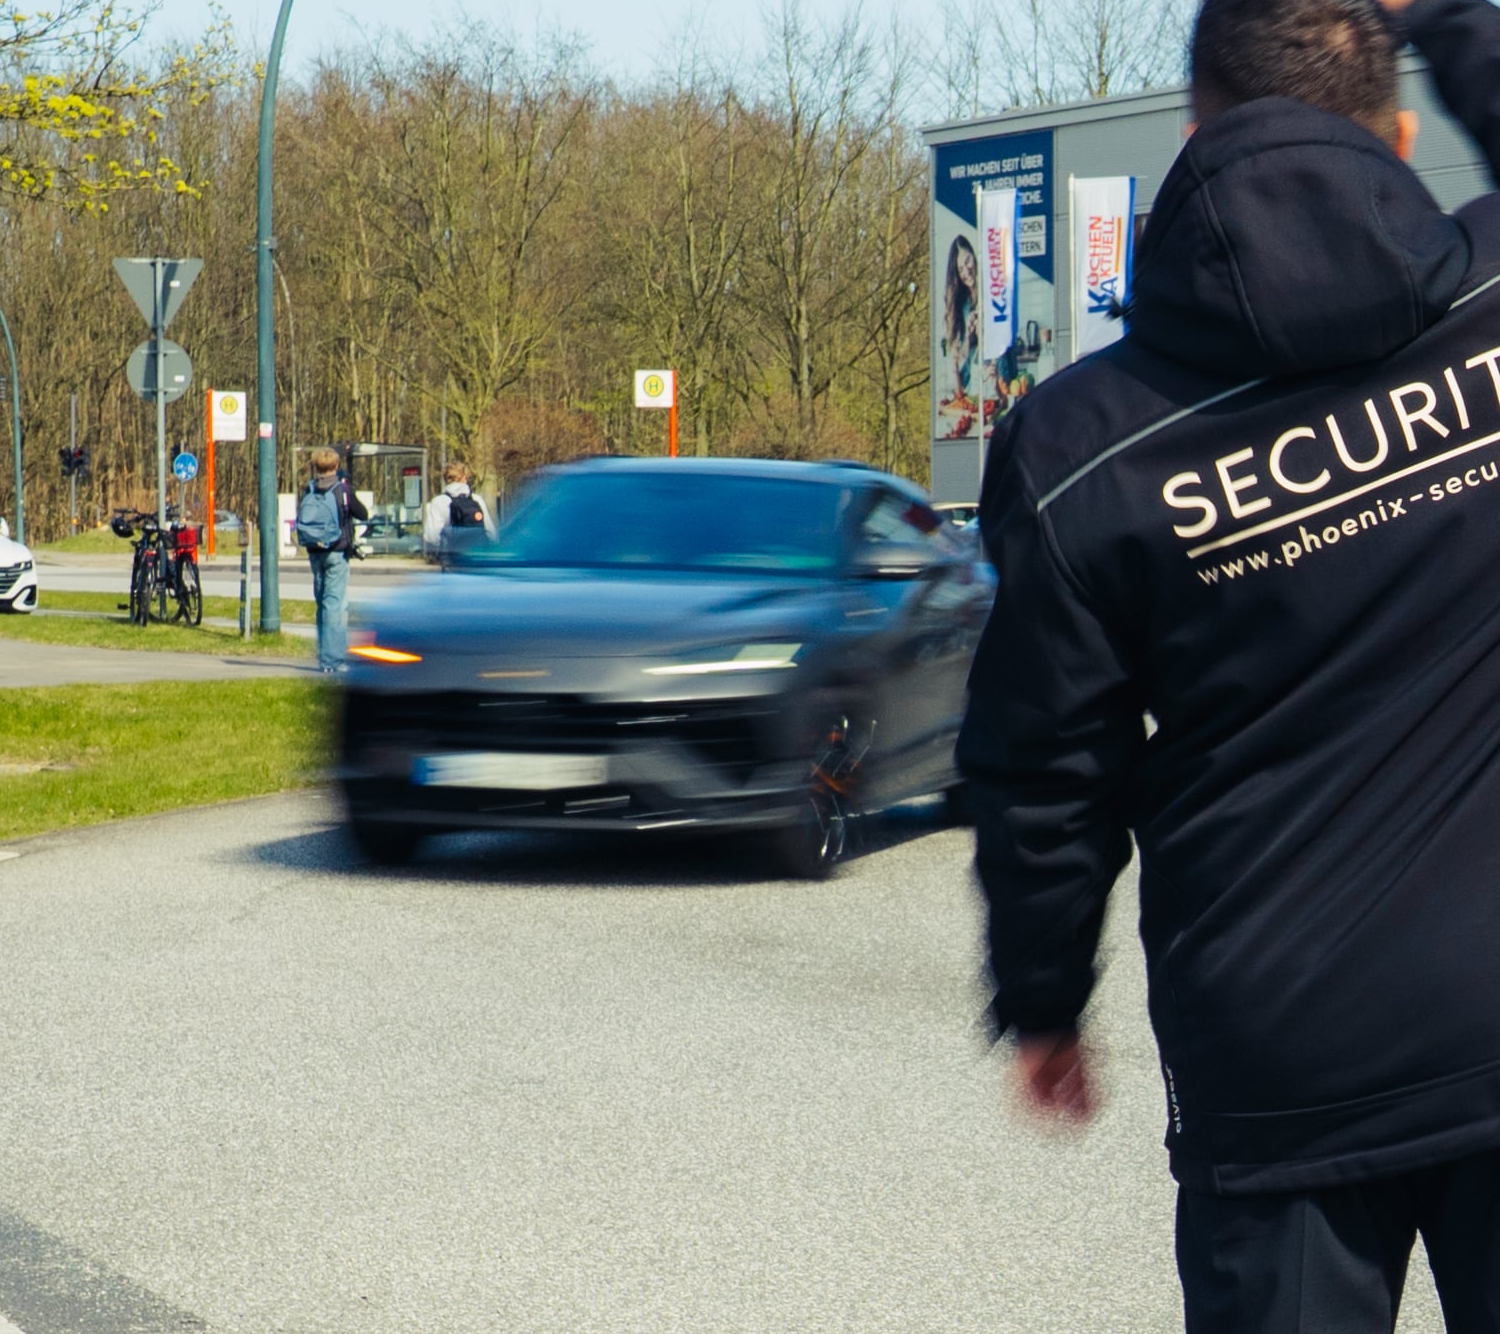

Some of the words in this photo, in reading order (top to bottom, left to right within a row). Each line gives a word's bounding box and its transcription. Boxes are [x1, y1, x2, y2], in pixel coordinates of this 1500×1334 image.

[950, 165, 966, 179] WIR
[966, 160, 1001, 177] MACHEN
[1002, 157, 1019, 173] SEIT
[1021, 153, 1044, 170] ÜBER
[1016, 172, 1044, 187] IMMER
